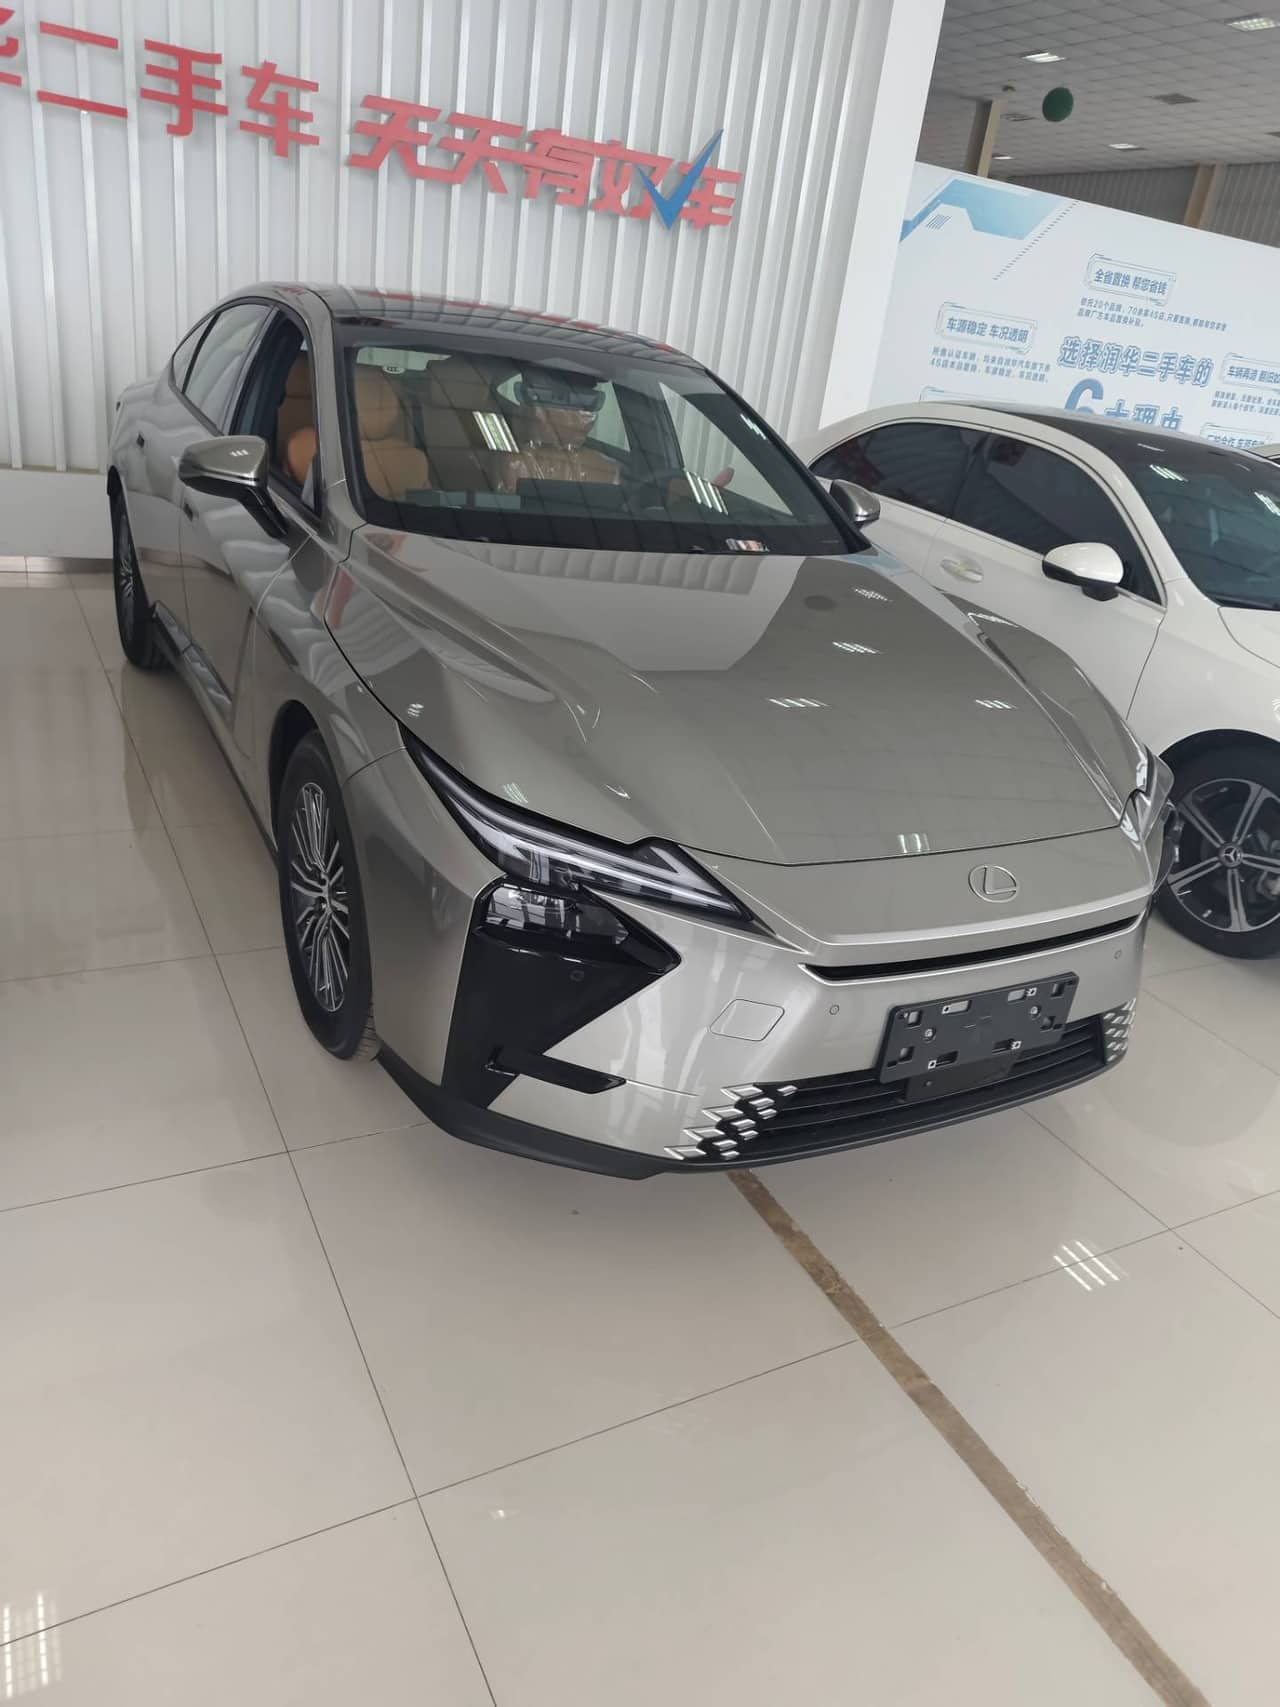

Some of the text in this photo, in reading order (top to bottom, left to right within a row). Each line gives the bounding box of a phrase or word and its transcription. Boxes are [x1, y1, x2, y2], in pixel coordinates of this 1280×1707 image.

[347, 94, 742, 229] 天天有好车
[946, 316, 1030, 344] 车源稳定 车况透明
[1058, 335, 1214, 387] 选择润华二手车的
